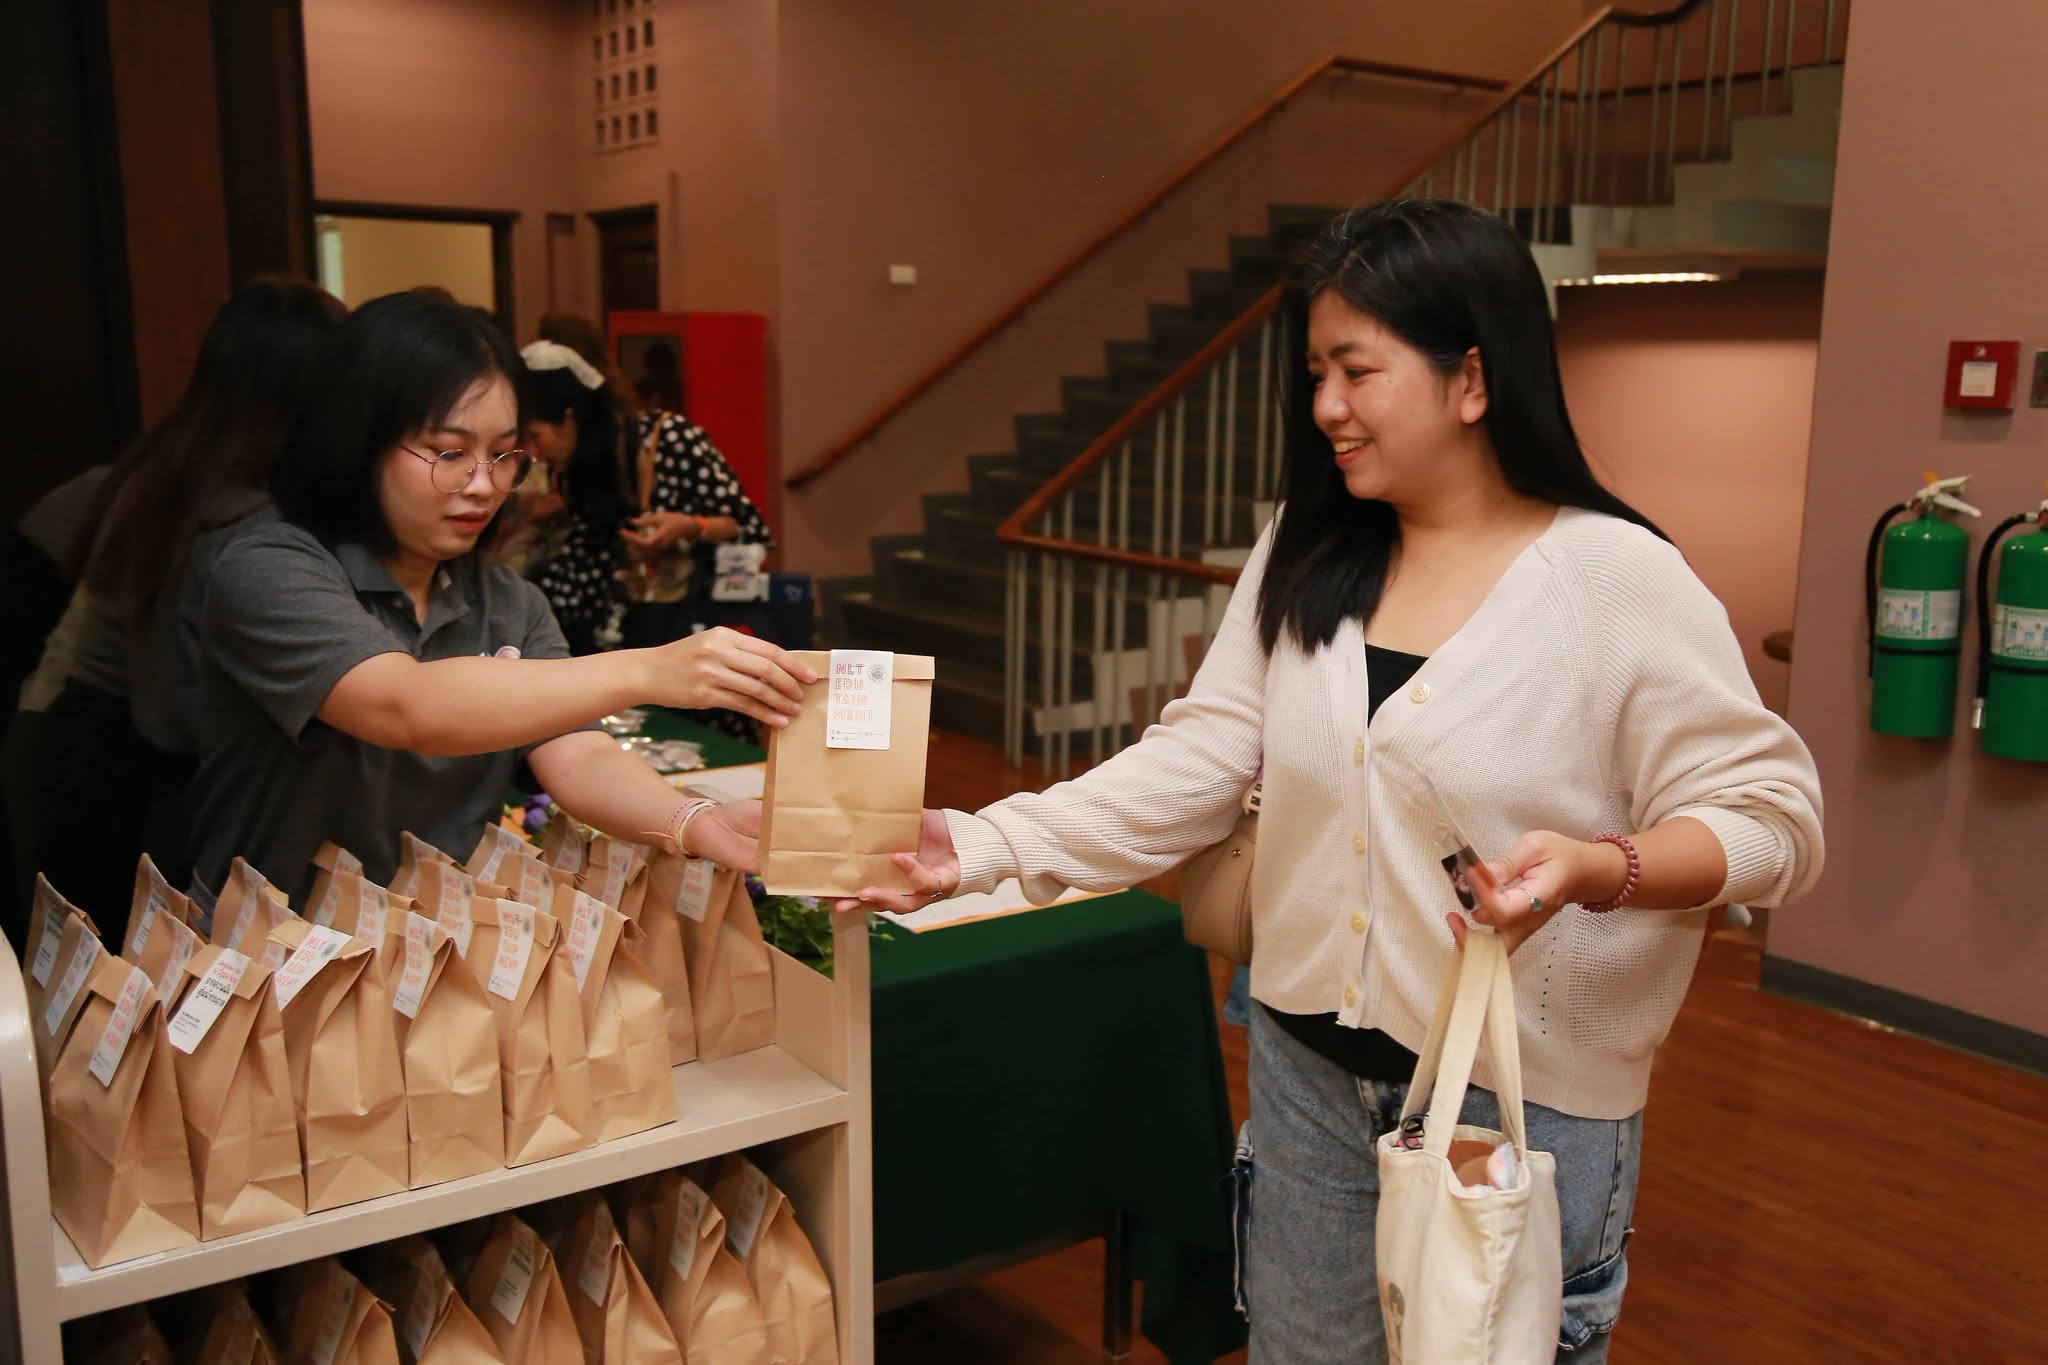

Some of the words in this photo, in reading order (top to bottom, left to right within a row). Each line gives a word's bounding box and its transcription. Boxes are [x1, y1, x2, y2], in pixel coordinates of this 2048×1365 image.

[836, 663, 864, 675] NLT
[835, 678, 864, 690] EDU
[833, 693, 868, 706] TAIN
[833, 709, 874, 721] MENT
